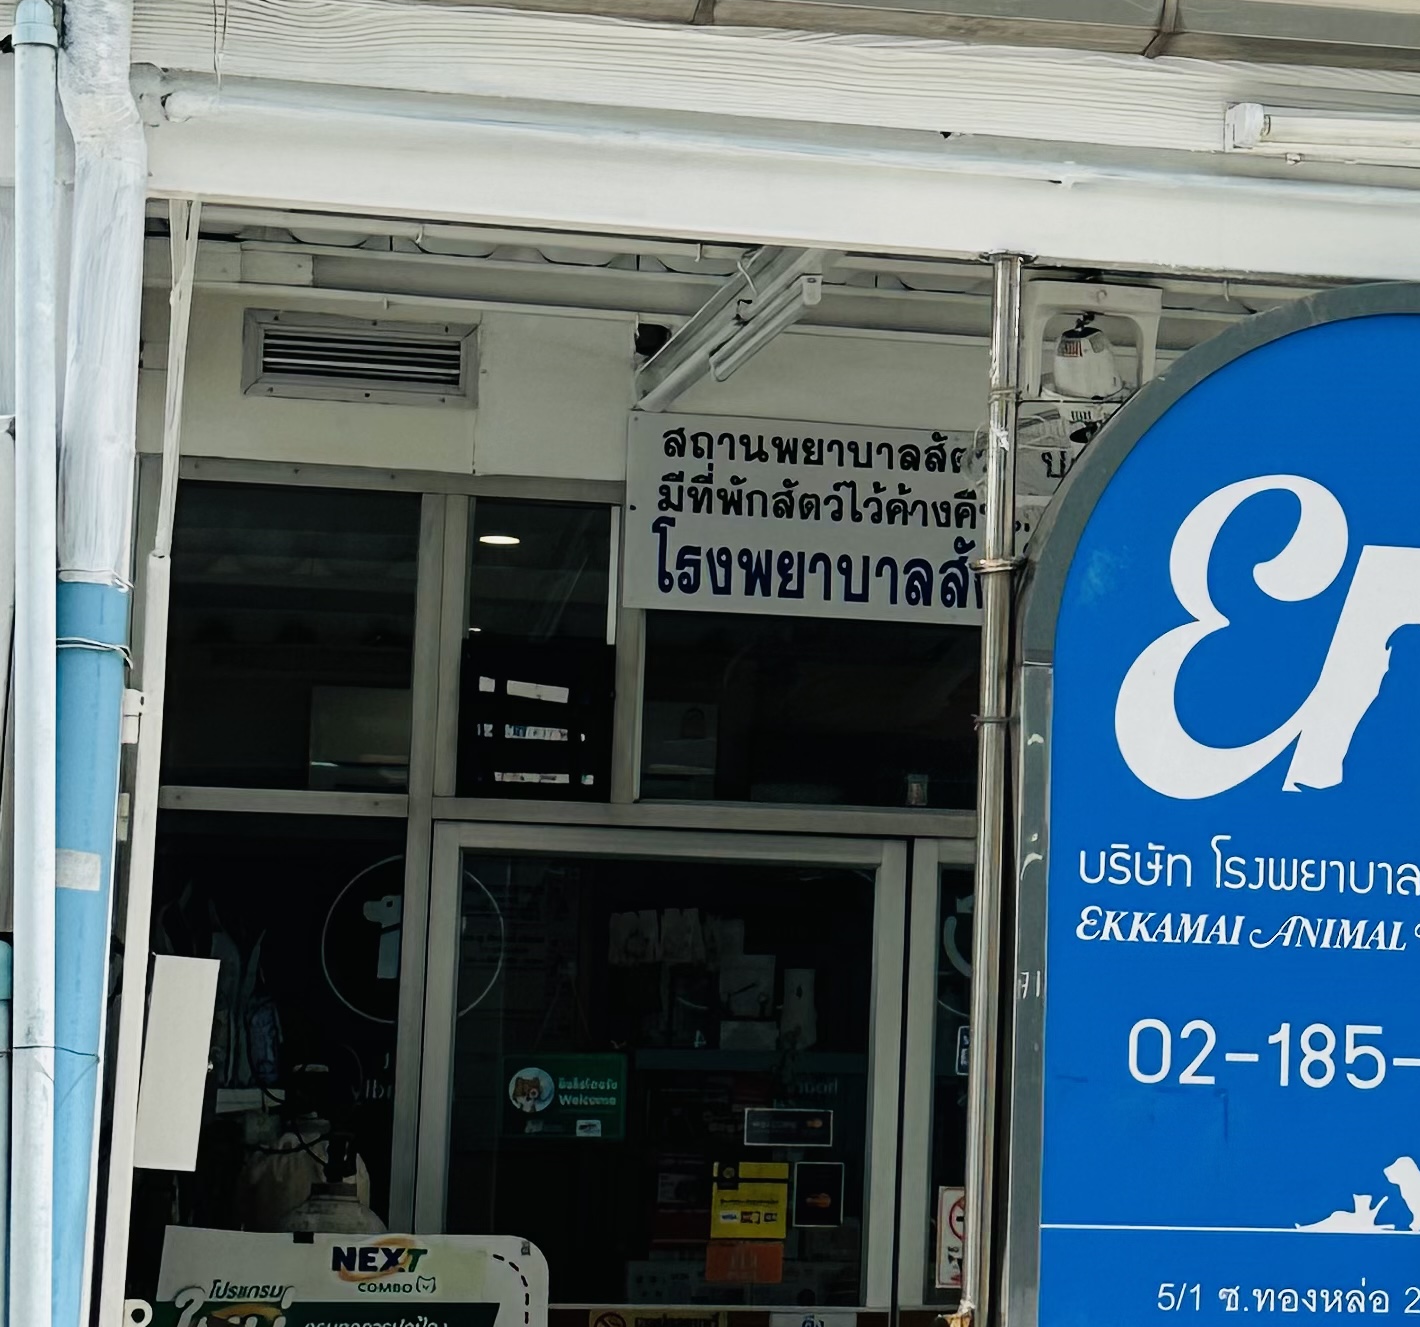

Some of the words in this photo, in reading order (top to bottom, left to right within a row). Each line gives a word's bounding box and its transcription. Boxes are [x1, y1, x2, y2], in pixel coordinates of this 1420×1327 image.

[657, 458, 986, 530] มีที่พักสัตว์ไว้ค้างคื
[1078, 841, 1193, 889] บริษัท
[1075, 905, 1243, 946] EKKAMAI
[1249, 913, 1408, 952] ANIMAL
[331, 1245, 428, 1273] NEXT
[208, 1278, 284, 1300] โปรแกรม
[1157, 1281, 1201, 1313] 5/1
[1218, 1277, 1390, 1314] ซ.ทองหล่อ
